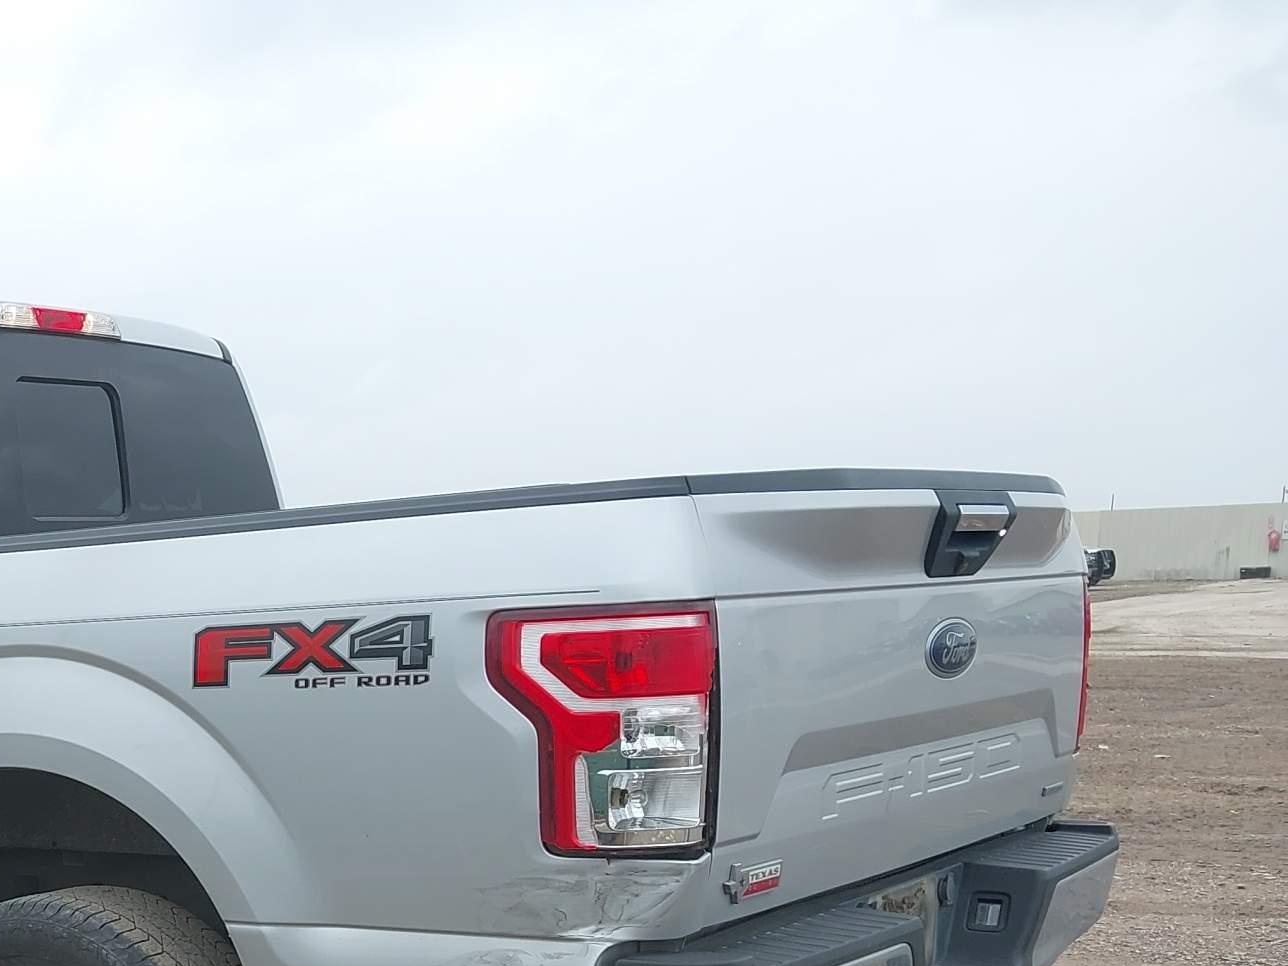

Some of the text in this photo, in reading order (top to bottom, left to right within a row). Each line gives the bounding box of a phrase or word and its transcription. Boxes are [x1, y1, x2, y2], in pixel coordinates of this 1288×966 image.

[193, 615, 433, 687] FX4
[294, 674, 430, 689] OFF ROAD
[749, 865, 781, 882] TEXAS
